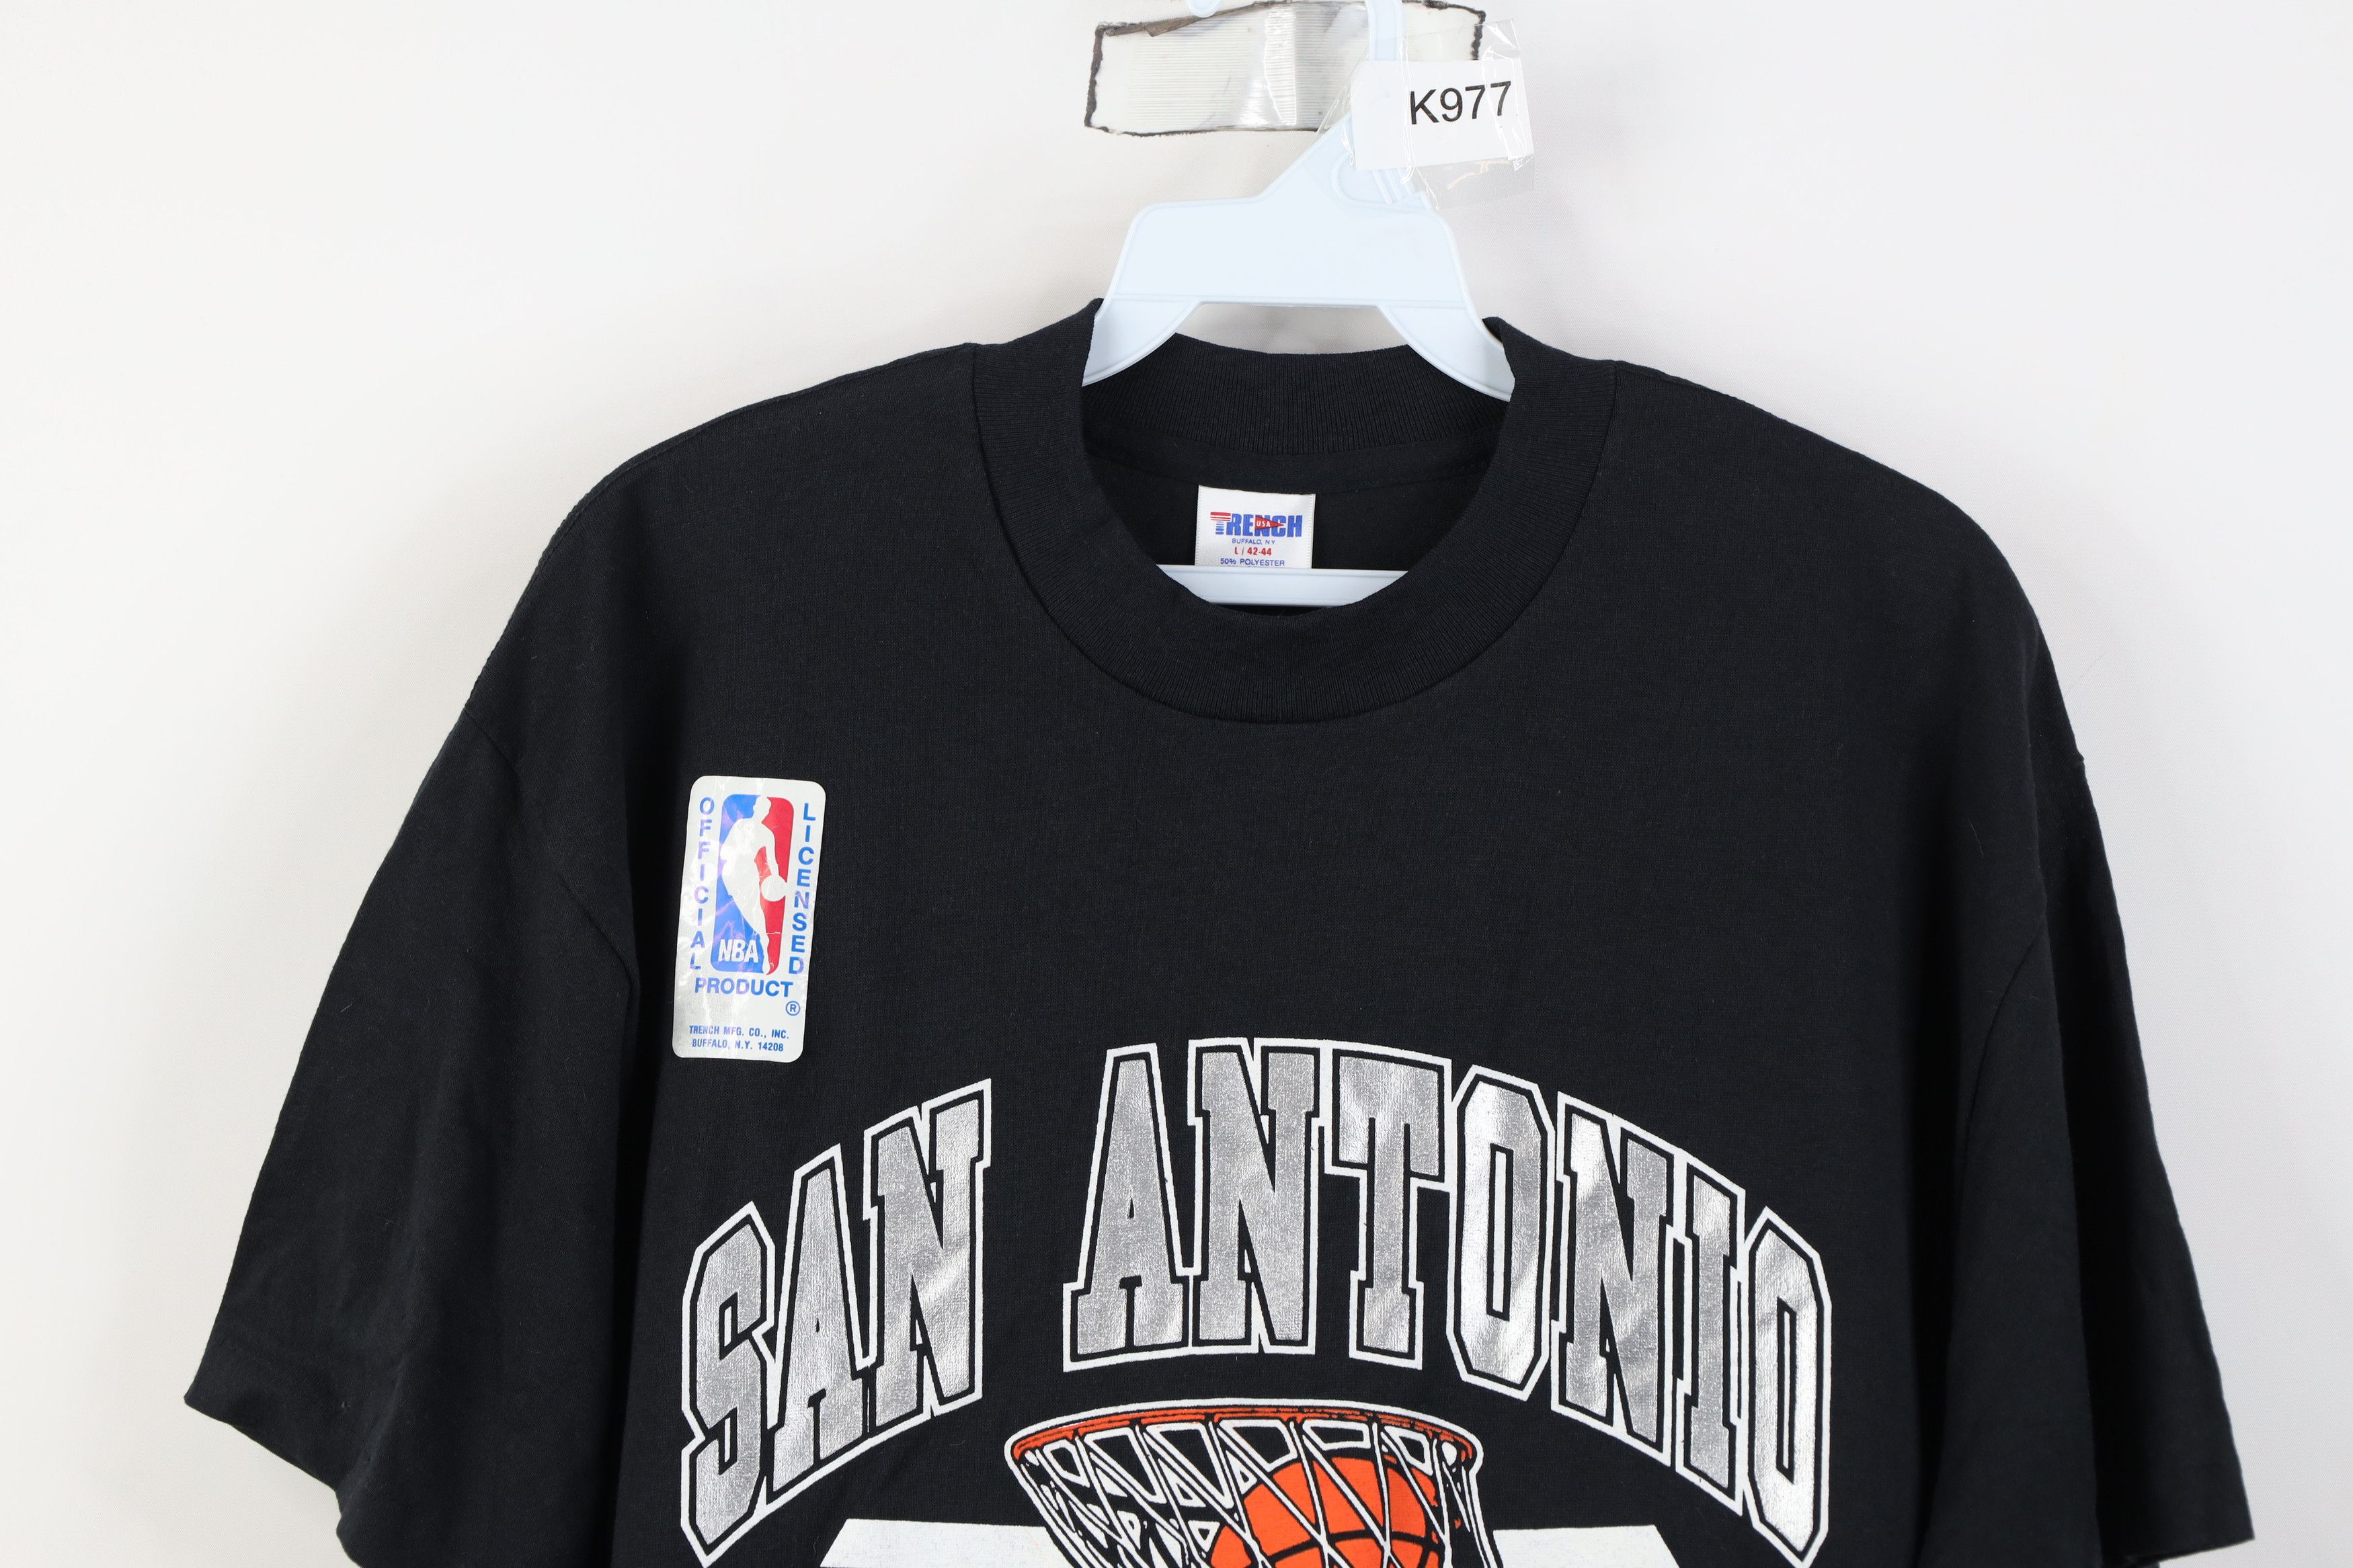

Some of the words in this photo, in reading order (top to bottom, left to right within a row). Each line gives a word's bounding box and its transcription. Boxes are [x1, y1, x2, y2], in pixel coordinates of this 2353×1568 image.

[1409, 80, 1512, 126] K977
[1210, 511, 1303, 538] TRENCH
[1256, 520, 1271, 528] USA
[1240, 559, 1285, 567] POLYESTER
[1247, 547, 1272, 556] 42-44
[690, 796, 715, 971] OFFICIAL
[788, 802, 816, 975] LICENSED
[717, 938, 760, 964] NBA
[694, 977, 794, 998] PRODUCT
[689, 1025, 720, 1034] TRENCH
[723, 1026, 745, 1036] MFG.
[749, 1028, 767, 1038] CO.,
[771, 1029, 790, 1039] INC.
[692, 1038, 731, 1050] BUFFALO,
[735, 1040, 753, 1050] N.Y.
[758, 1042, 784, 1052] 14208
[681, 1077, 992, 1567] SAN
[1062, 1037, 1831, 1567] ANTONIO
